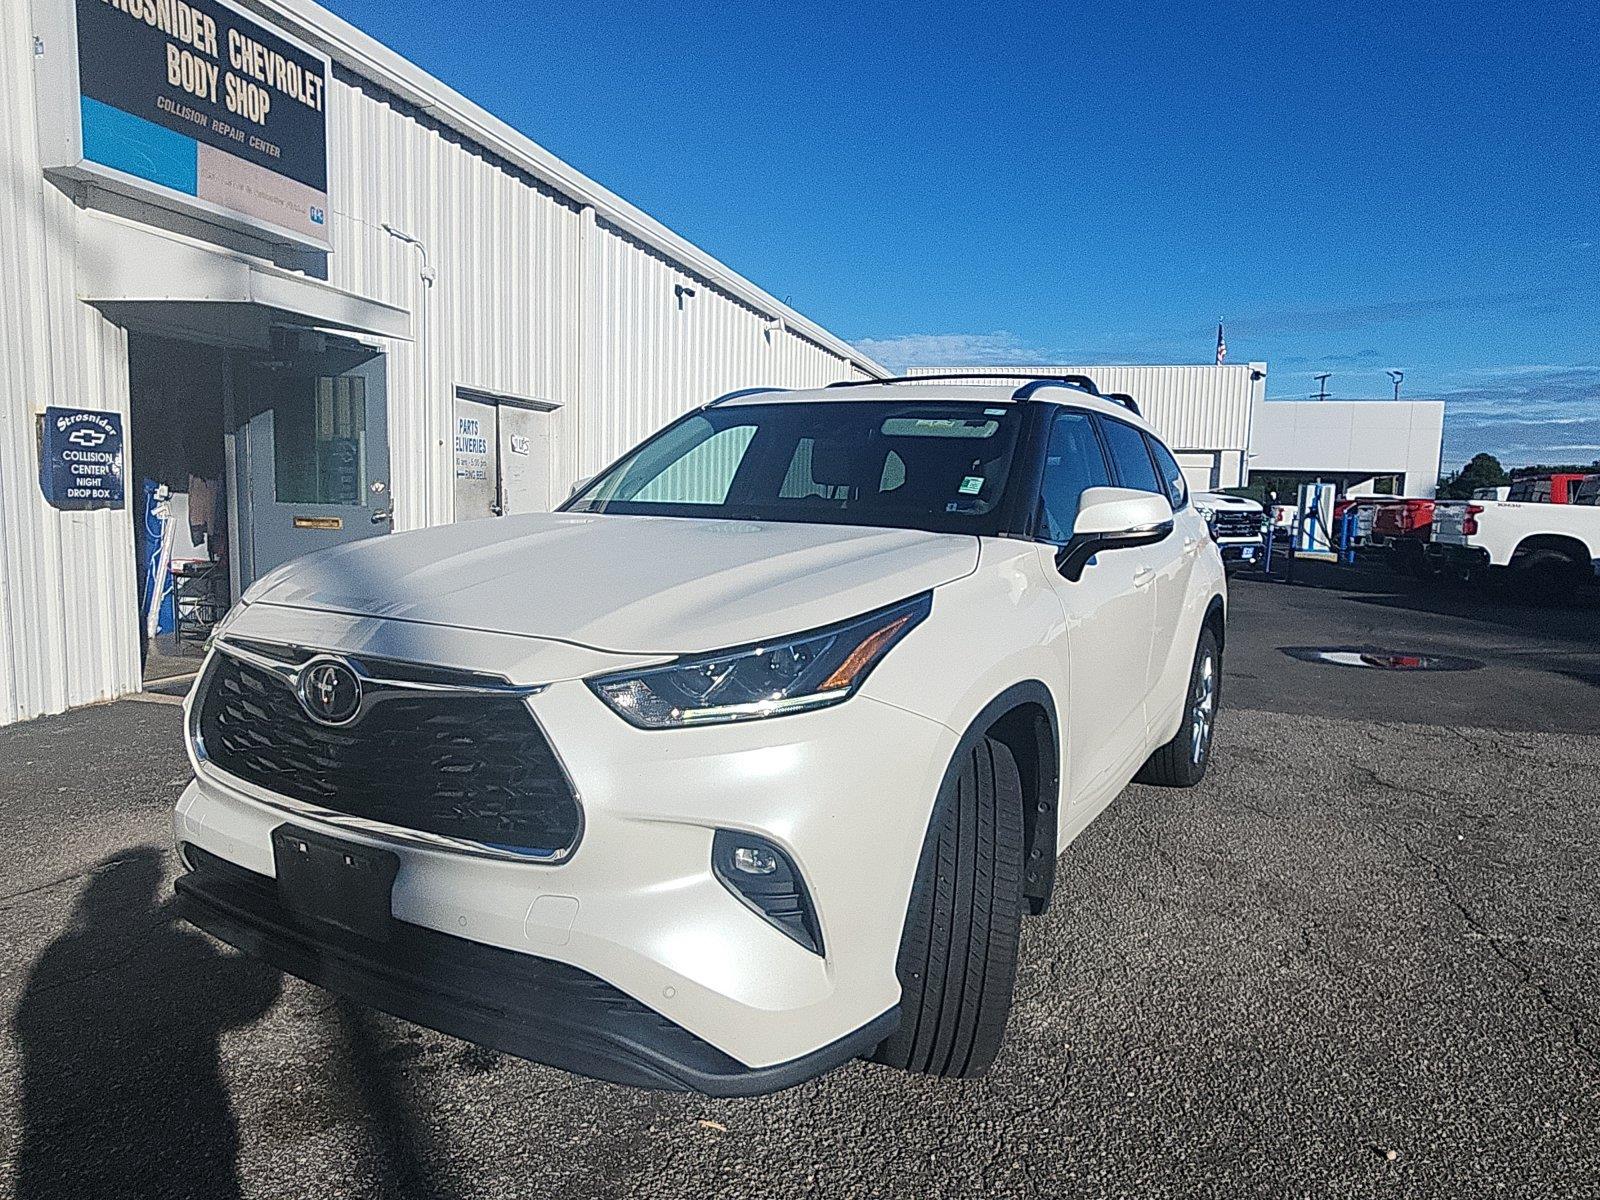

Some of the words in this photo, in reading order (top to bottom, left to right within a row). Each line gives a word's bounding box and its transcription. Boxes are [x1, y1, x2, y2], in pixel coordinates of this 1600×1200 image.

[101, 0, 219, 59] OSNIDER
[228, 28, 323, 112] CHEVROLET
[166, 42, 221, 104] BODY
[225, 71, 270, 126] SHOP
[156, 95, 208, 127] COLLISION
[211, 119, 245, 143] REPAIR
[249, 135, 280, 158] CENTER
[57, 413, 117, 435] Strosnider
[459, 418, 479, 436] PARTS
[62, 450, 113, 462] COLLISION
[71, 464, 107, 475] CENTER
[76, 477, 102, 487] NIGHT
[67, 488, 91, 498] DROP
[92, 489, 111, 498] BOX
